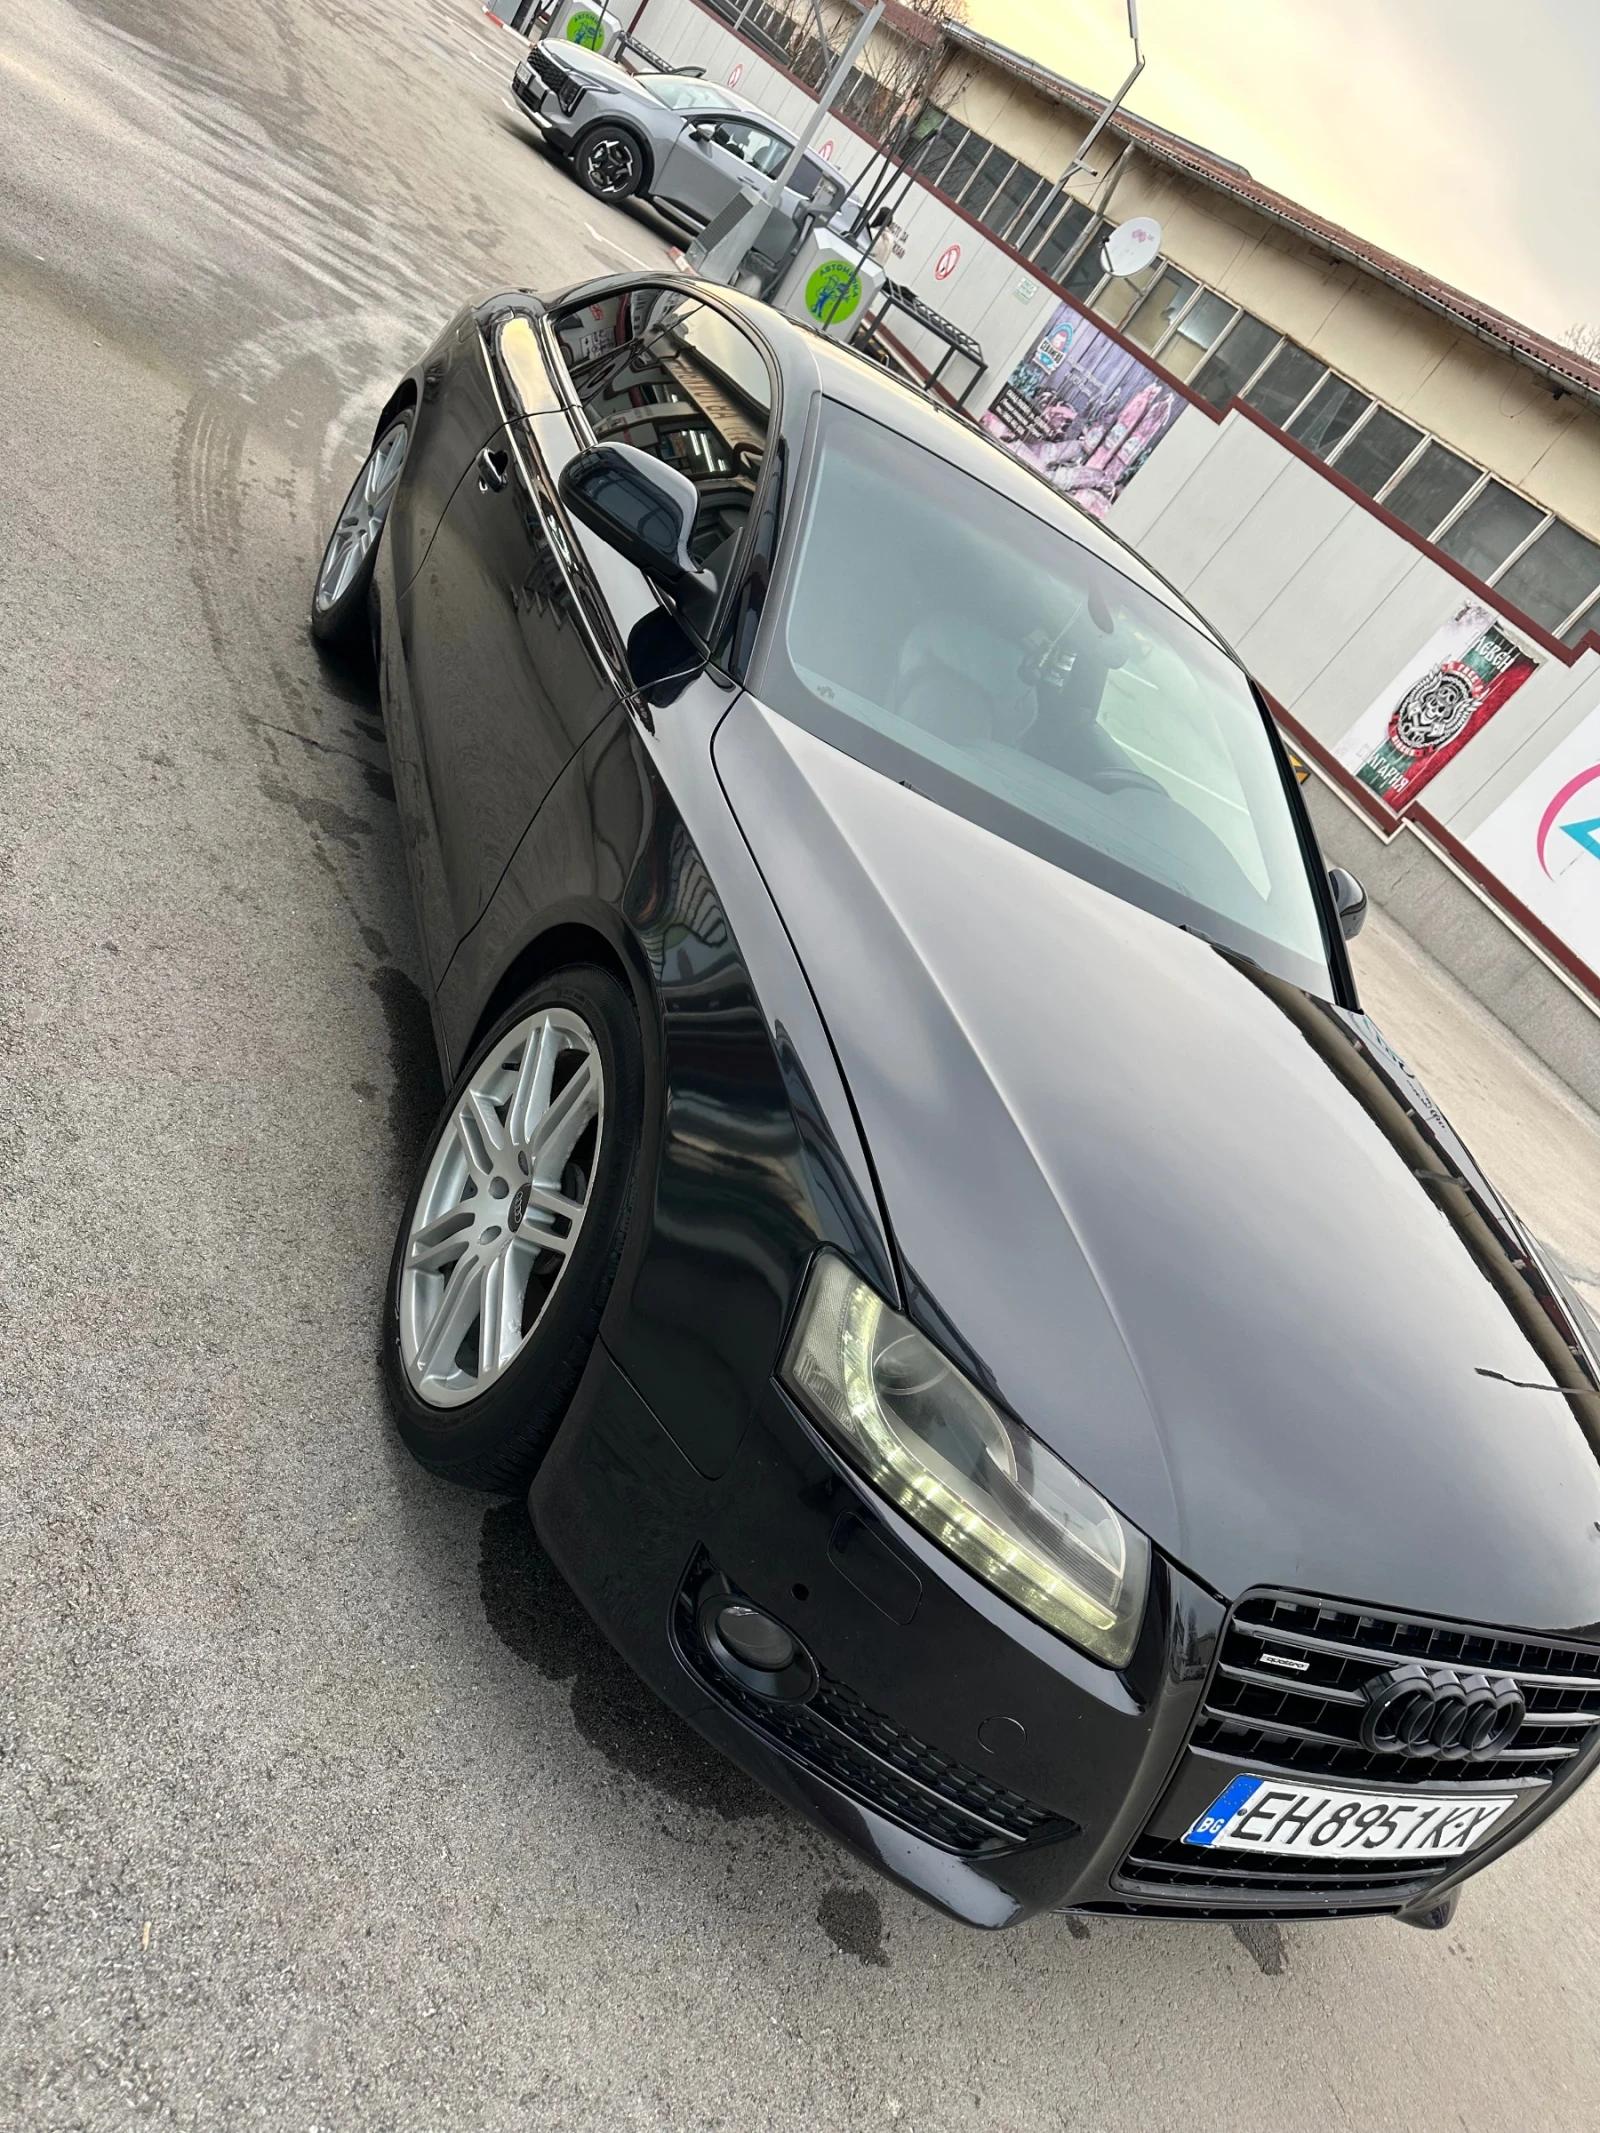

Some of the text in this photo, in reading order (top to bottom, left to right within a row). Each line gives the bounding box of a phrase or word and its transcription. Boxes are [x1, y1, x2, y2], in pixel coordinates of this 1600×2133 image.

[820, 264, 859, 298] АВТОМИКА
[1266, 1656, 1305, 1669] quattro
[1200, 1816, 1225, 1834] BG
